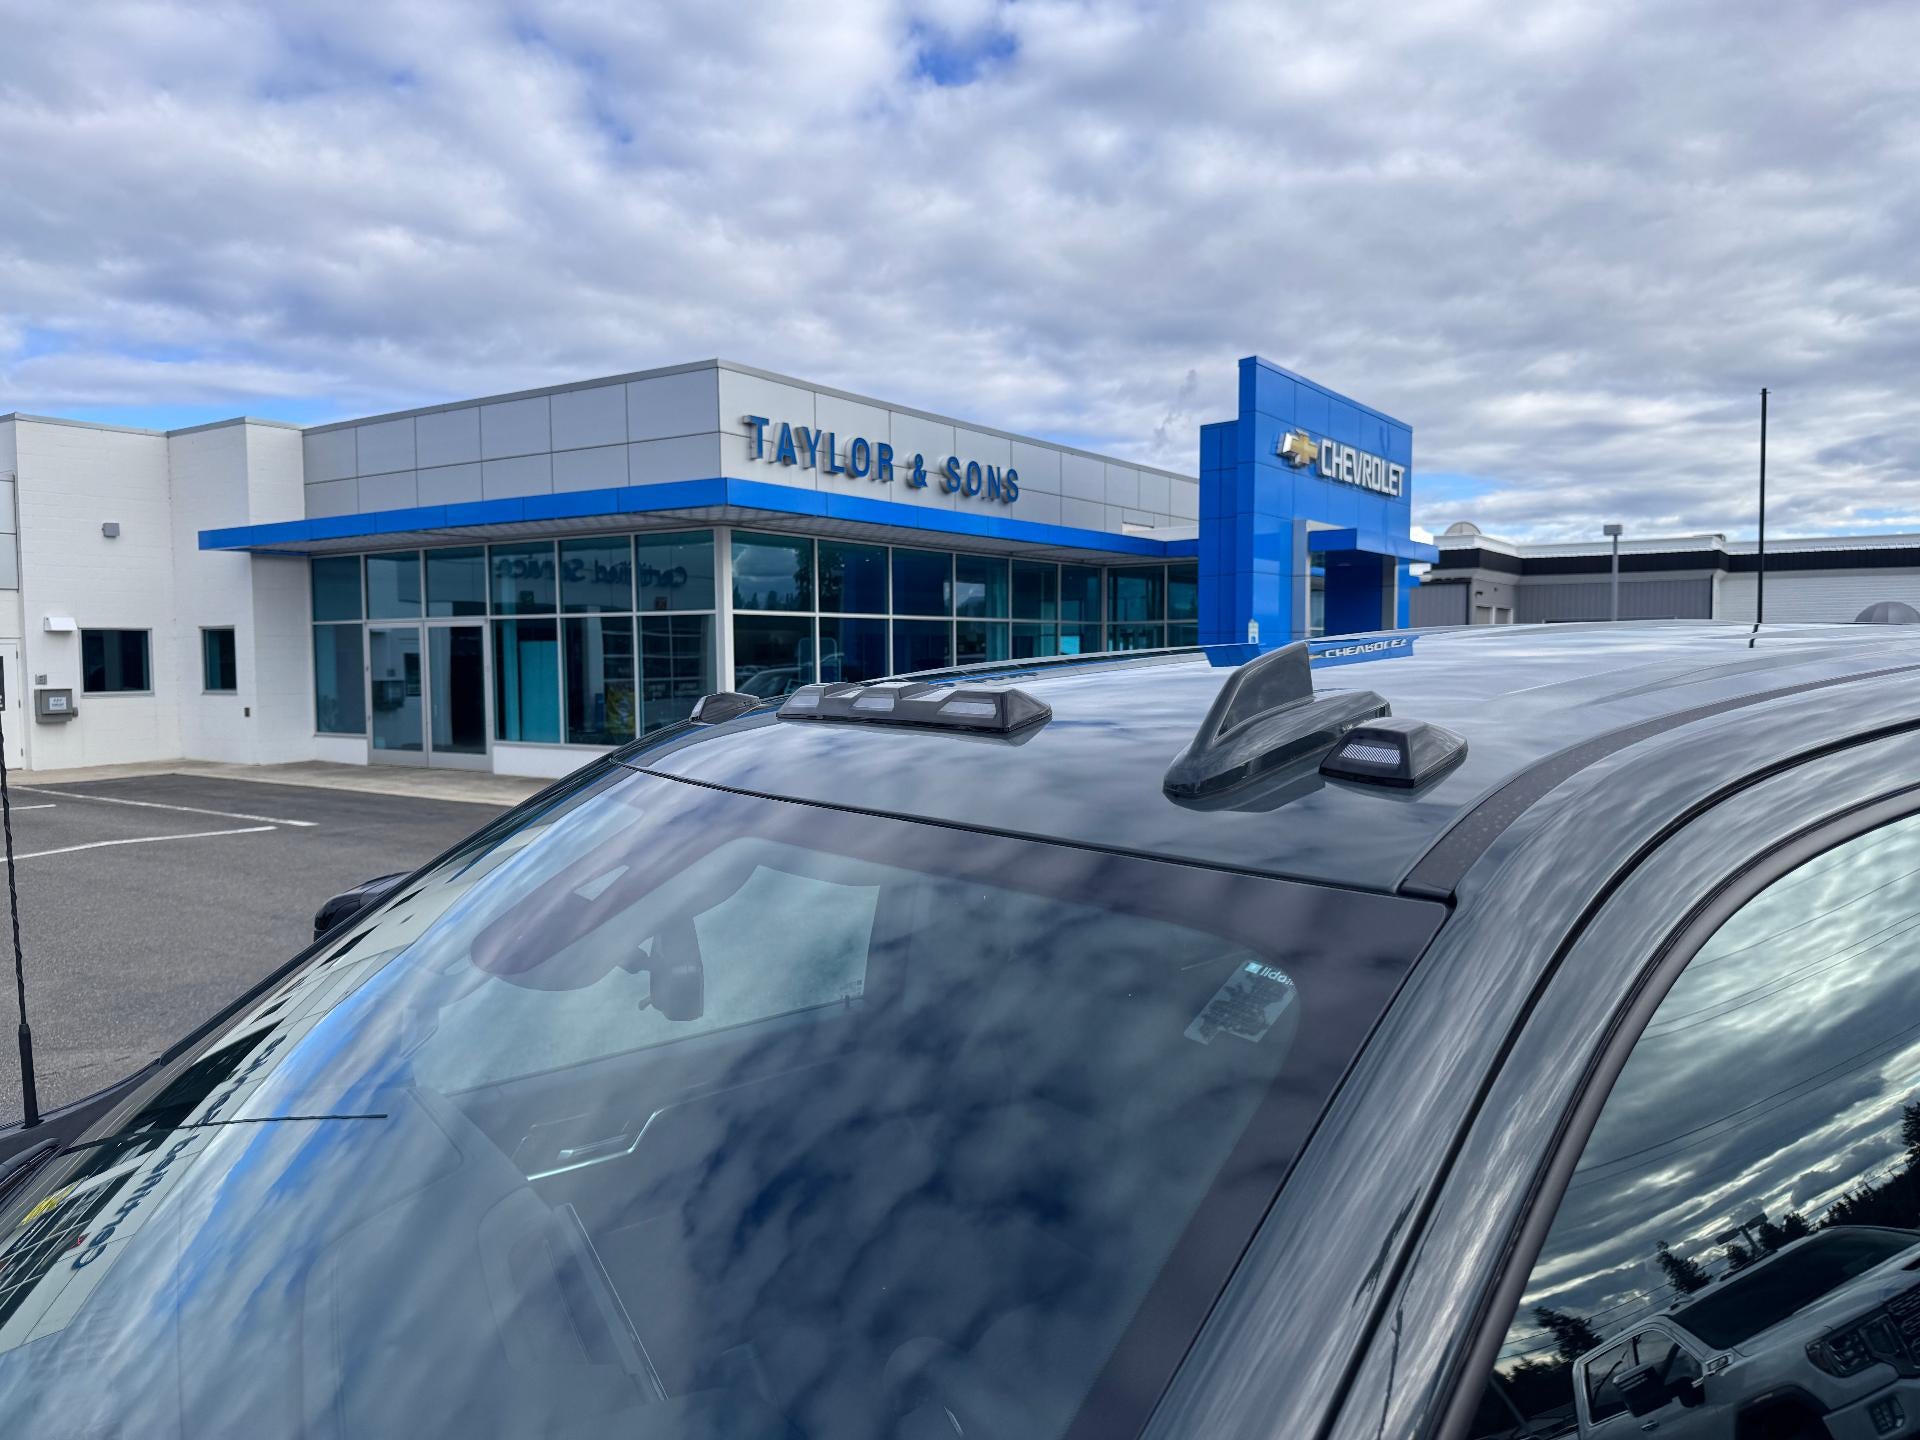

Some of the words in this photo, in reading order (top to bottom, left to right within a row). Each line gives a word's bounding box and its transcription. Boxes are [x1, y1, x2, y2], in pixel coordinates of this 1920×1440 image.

[742, 414, 894, 482] TAYLOR
[906, 453, 927, 489] &
[939, 455, 1019, 503] SONS
[1319, 438, 1405, 497] CHEVROLET
